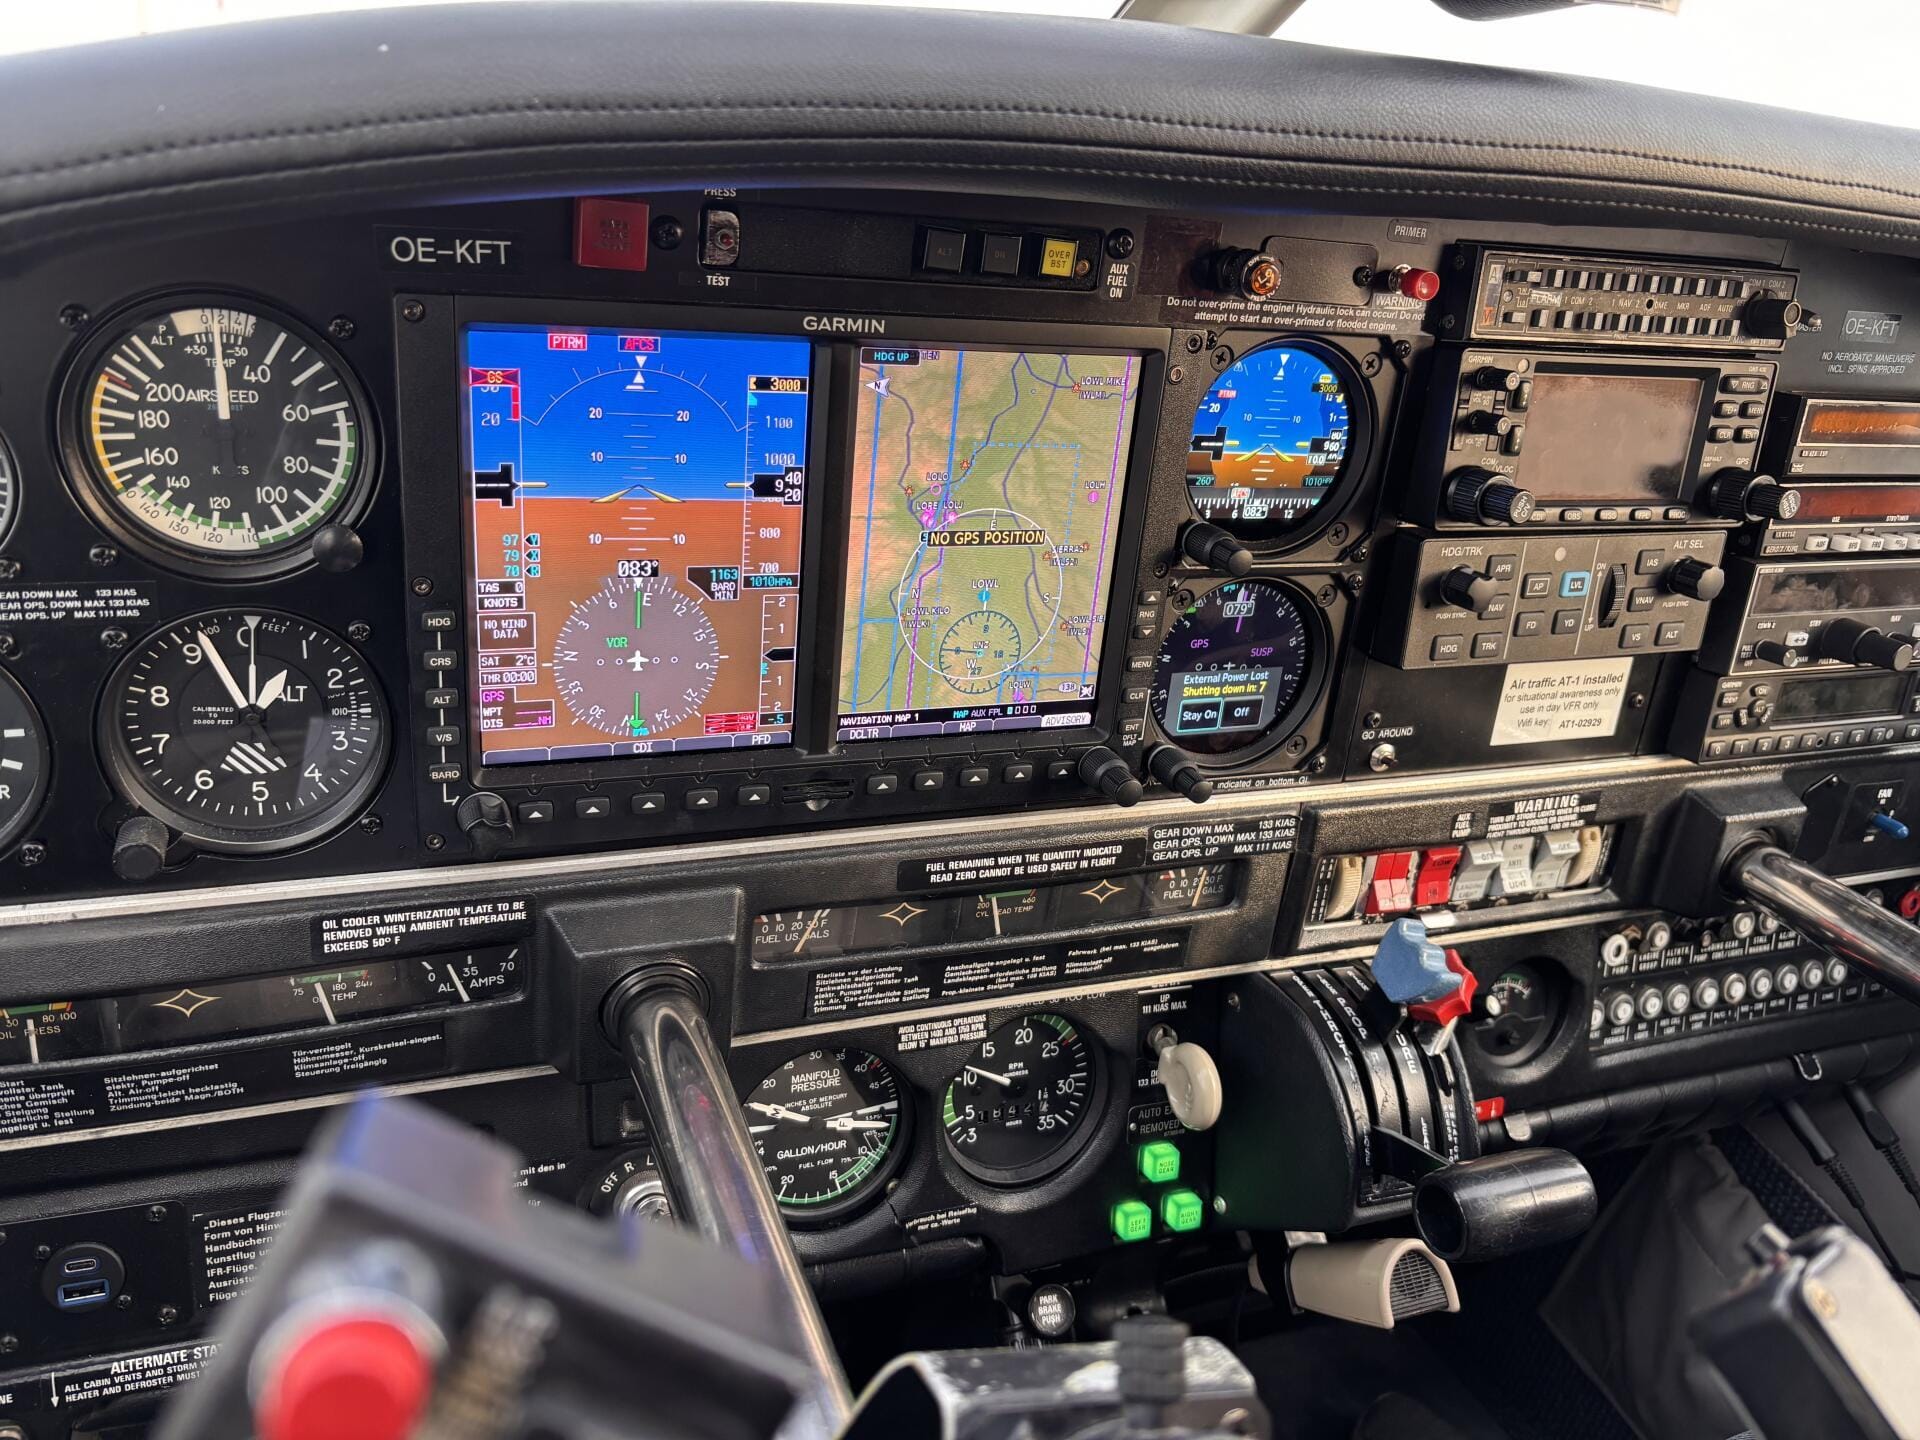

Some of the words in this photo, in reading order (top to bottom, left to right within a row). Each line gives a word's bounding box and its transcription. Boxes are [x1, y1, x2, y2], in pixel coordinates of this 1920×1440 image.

[1394, 225, 1427, 238] PRIMER
[391, 236, 512, 265] OE-KFT
[1047, 248, 1071, 260] OVER
[1050, 258, 1066, 270] BST
[1110, 264, 1129, 275] AUX
[706, 275, 730, 287] TEST
[1107, 275, 1128, 287] FUEL
[1109, 287, 1123, 299] ON
[1167, 297, 1180, 306] Do
[1182, 298, 1196, 307] not
[1199, 301, 1245, 311] over-prime
[1248, 302, 1260, 311] the
[1296, 305, 1334, 316] Hydraulic
[1336, 306, 1354, 316] lock
[1356, 308, 1371, 317] can
[1400, 310, 1411, 320] Do
[803, 315, 886, 334] GARMIN
[1194, 312, 1228, 323] attempt
[1230, 313, 1238, 321] to
[1240, 314, 1260, 323] start
[1262, 316, 1272, 324] an
[1274, 316, 1325, 328] over-primed
[1326, 318, 1335, 326] or
[1337, 318, 1367, 329] flooded
[1369, 321, 1398, 331] engine.
[1846, 318, 1899, 336] OE-KFT
[553, 336, 583, 349] PTRM
[625, 338, 655, 350] AFCS
[874, 352, 894, 361] HDG
[897, 352, 910, 361] UP
[770, 378, 800, 391] 3000
[146, 384, 186, 402] 200
[138, 410, 170, 428] 180
[145, 448, 178, 466] 160
[257, 486, 288, 504] 100
[760, 528, 780, 538] 800
[930, 532, 950, 544] NO
[954, 532, 982, 544] GPS
[985, 530, 1045, 544] POSITION
[1674, 541, 1689, 549] ALT
[1689, 540, 1704, 548] SEL
[1441, 546, 1483, 557] HDG/TRK
[1647, 558, 1659, 566] IAS
[1496, 564, 1511, 572] APR
[479, 583, 499, 592] TAS
[972, 579, 999, 589] LOWL
[1571, 580, 1582, 588] LVL
[22, 591, 52, 599] DOWN
[56, 590, 78, 598] MAX
[715, 591, 733, 599] MIN
[1635, 596, 1654, 604] VNAV
[484, 598, 518, 608] KNOTS
[1488, 604, 1504, 612] NAV
[1139, 610, 1155, 618] RNG
[428, 618, 451, 626] HDG
[484, 620, 497, 629] NO
[502, 619, 527, 628] WIND
[262, 622, 286, 634] FEET
[493, 629, 518, 639] DATA
[606, 637, 628, 648] VOR
[1190, 639, 1209, 648] GPS
[1482, 642, 1496, 650] TRK
[1250, 647, 1273, 656] SUSP
[1440, 644, 1458, 653] HDG
[430, 658, 451, 666] CRS
[1184, 674, 1220, 684] External
[1222, 673, 1248, 682] Power
[1251, 671, 1269, 680] Lost
[1510, 680, 1525, 689] Air
[1528, 677, 1556, 688] traffic
[1558, 676, 1580, 686] AT-1
[1583, 673, 1624, 685] installed
[1183, 685, 1220, 696] Shutting
[1222, 685, 1245, 694] down
[1247, 684, 1257, 692] in:
[1504, 694, 1515, 702] for
[1517, 691, 1558, 701] situational
[1560, 689, 1602, 698] awareness
[1604, 687, 1620, 696] only
[433, 695, 450, 704] ALT
[483, 691, 504, 702] GPS
[1130, 692, 1144, 700] CLR
[483, 707, 502, 716] WPT
[1183, 711, 1202, 722] Stay
[1204, 710, 1217, 719] On
[1234, 707, 1250, 717] Off
[483, 719, 503, 728] DIS
[840, 715, 893, 726] NAVIGATION
[895, 714, 911, 722] MAP
[1045, 715, 1086, 725] ADVISORY
[1559, 718, 1602, 728] AT1-02929
[960, 722, 976, 732] MAP
[1126, 723, 1139, 731] ENT
[436, 734, 452, 742] V/S
[752, 734, 771, 745] PFD
[850, 729, 879, 739] DCLTR
[1362, 730, 1375, 740] GO
[1378, 728, 1413, 738] AROUND
[633, 742, 653, 753] CDI
[432, 771, 460, 779] BARO
[1514, 794, 1580, 813] WARNING
[1154, 828, 1180, 839] GEAR
[1183, 826, 1212, 836] DOWN
[1214, 824, 1234, 833] MAX
[1259, 820, 1273, 829] 133
[1275, 818, 1295, 828] KIAS
[926, 863, 945, 872] FUEL
[949, 858, 995, 870] REMAINING
[998, 855, 1022, 865] WHEN
[1025, 854, 1040, 862] THE
[1043, 849, 1081, 861] QUANTITY
[1083, 846, 1122, 857] INDICATED
[931, 873, 953, 883] READ
[956, 871, 977, 880] ZERO
[979, 867, 1011, 878] CANNOT
[1015, 866, 1025, 874] BE
[1027, 864, 1048, 873] USED
[1050, 861, 1077, 871] SAFELY
[1091, 857, 1116, 867] FLIGHT
[323, 920, 338, 930] OIL
[342, 915, 380, 928] COOLER
[383, 908, 460, 924] WINTERIZATION
[464, 904, 493, 915] PLATE
[497, 904, 510, 912] TO
[513, 901, 525, 909] BE
[323, 928, 372, 941] REMOVED
[376, 924, 406, 935] WHEN
[410, 919, 454, 932] AMBIENT
[458, 912, 527, 927] TEMPERATURE
[324, 940, 368, 953] EXCEEDS
[470, 975, 505, 989] AMPS
[792, 1069, 840, 1083] MANIFOLD
[791, 1078, 841, 1093] PRESSURE
[777, 1140, 847, 1159] GALLON/HOUR
[204, 1235, 273, 1253] Handbüchern
[110, 1350, 188, 1375] ALTERNATE
[65, 1389, 100, 1402] HEATER
[103, 1385, 122, 1395] AND
[125, 1375, 173, 1392] DEFROSTER
